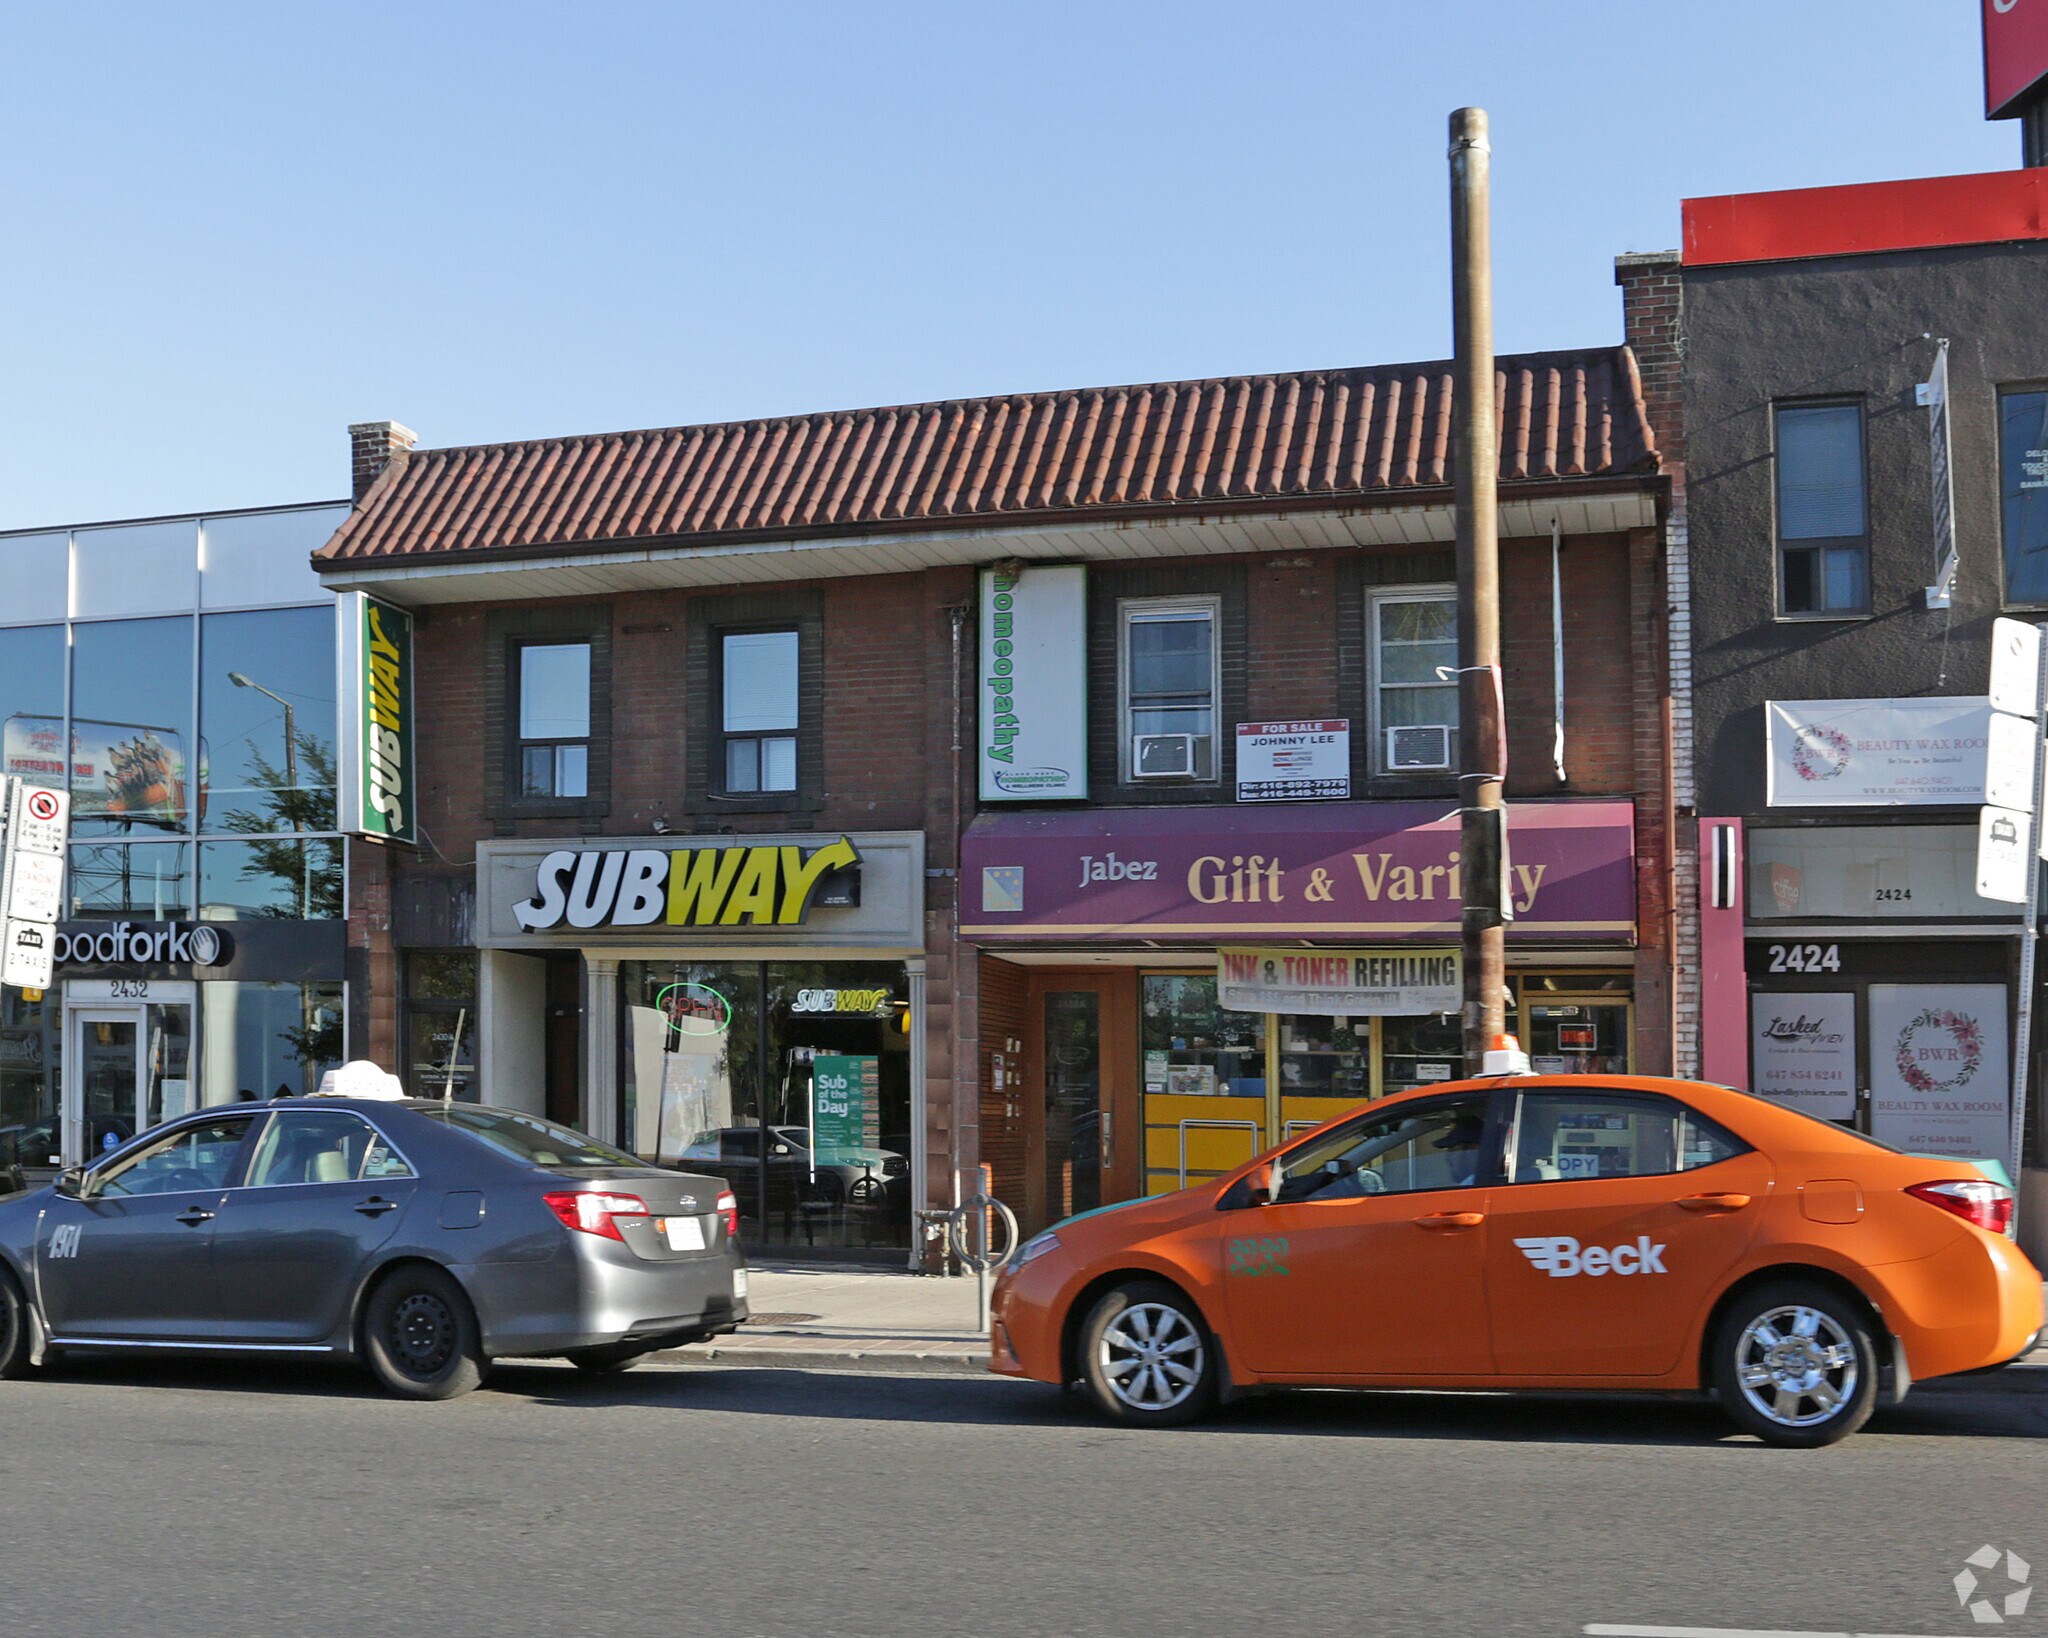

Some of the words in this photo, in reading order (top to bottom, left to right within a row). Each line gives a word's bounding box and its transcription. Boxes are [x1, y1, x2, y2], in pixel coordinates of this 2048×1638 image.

[368, 606, 404, 833] SUBWAY
[1261, 724, 1288, 734] FOR
[1290, 722, 1324, 732] SALE
[1250, 736, 1307, 747] JOHNNY
[1310, 735, 1335, 744] LEE
[1856, 739, 1913, 751] BEAUTY
[1915, 738, 1950, 750] WAX
[1954, 738, 1988, 749] ROO
[1259, 780, 1347, 789] 416-892-7979
[1260, 788, 1347, 798] 416-449-7600
[511, 834, 857, 934] SUBWAY
[1079, 852, 1158, 888] Jabez
[1187, 854, 1286, 904] Gift
[1303, 867, 1336, 902] &
[1352, 851, 1548, 912] Variy
[1876, 888, 1912, 901] 2424
[54, 921, 190, 962] oodfork
[1768, 944, 1841, 973] 2424
[1223, 954, 1259, 982] INK
[1263, 959, 1279, 986] &
[1283, 956, 1349, 987] TONER
[1355, 956, 1456, 987] REFILLING
[111, 980, 148, 998] 2432
[791, 988, 889, 1012] SUBWAY
[661, 996, 723, 1022] OPEN
[1761, 1014, 1825, 1038] Lashed
[1918, 1047, 1960, 1061] BWR
[818, 1074, 848, 1089] Sub
[1765, 1070, 1787, 1079] 647
[818, 1090, 829, 1099] of
[830, 1090, 848, 1099] the
[817, 1099, 849, 1118] Day
[1877, 1101, 1928, 1111] BEAUTY
[1932, 1101, 1961, 1111] WAX
[1963, 1102, 2004, 1112] ROOM
[1558, 1158, 1595, 1172] OPY
[1546, 1235, 1668, 1278] Beck
